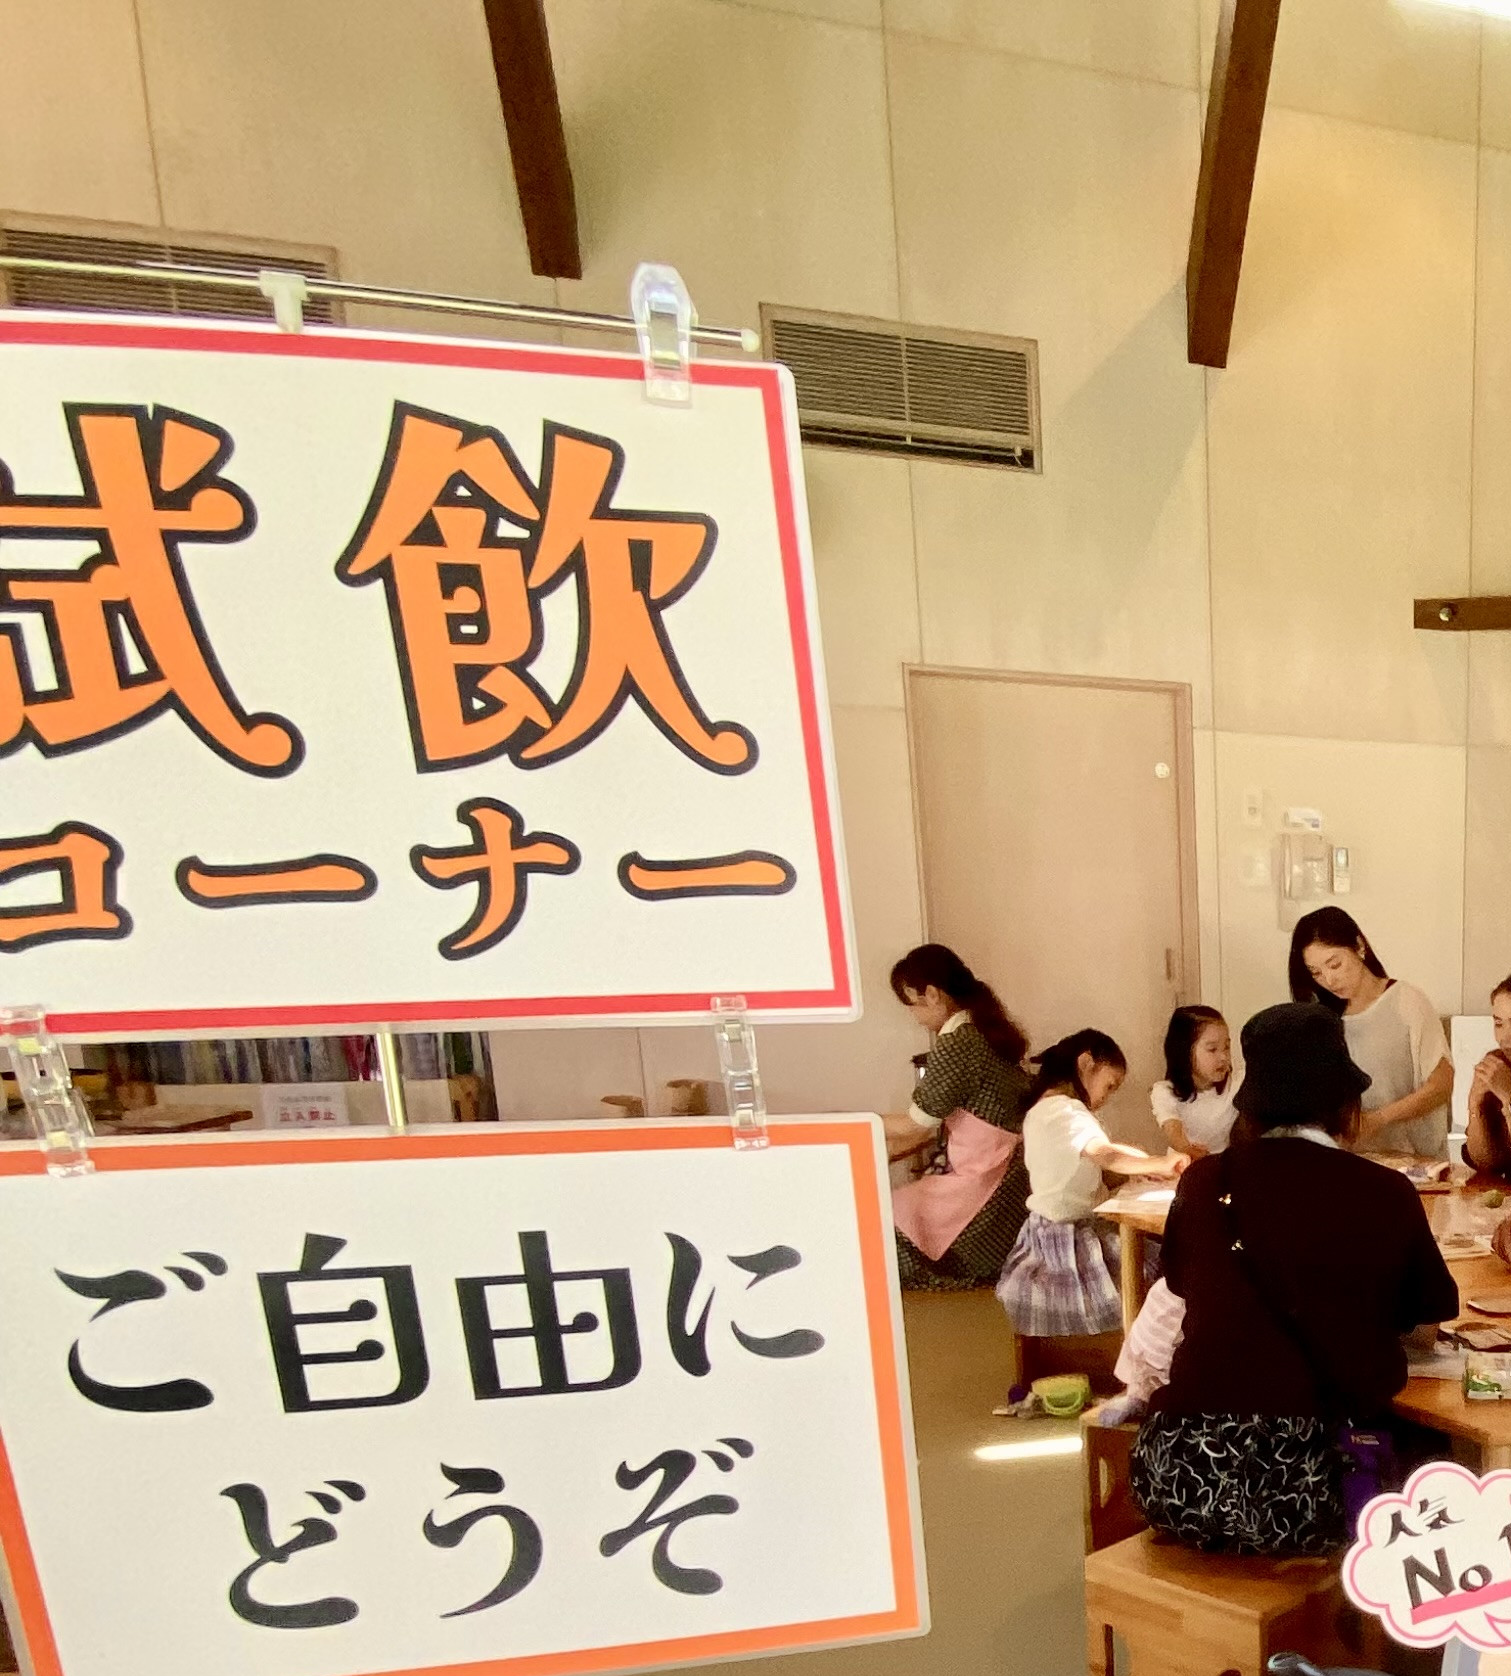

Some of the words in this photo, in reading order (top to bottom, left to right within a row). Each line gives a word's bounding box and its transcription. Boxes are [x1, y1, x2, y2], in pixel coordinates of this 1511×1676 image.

[0, 400, 759, 777] 試飲
[0, 797, 797, 961] コーナー
[53, 1230, 826, 1414] ご自由に
[218, 1437, 755, 1630] どうぞ
[1383, 1496, 1465, 1548] 人気
